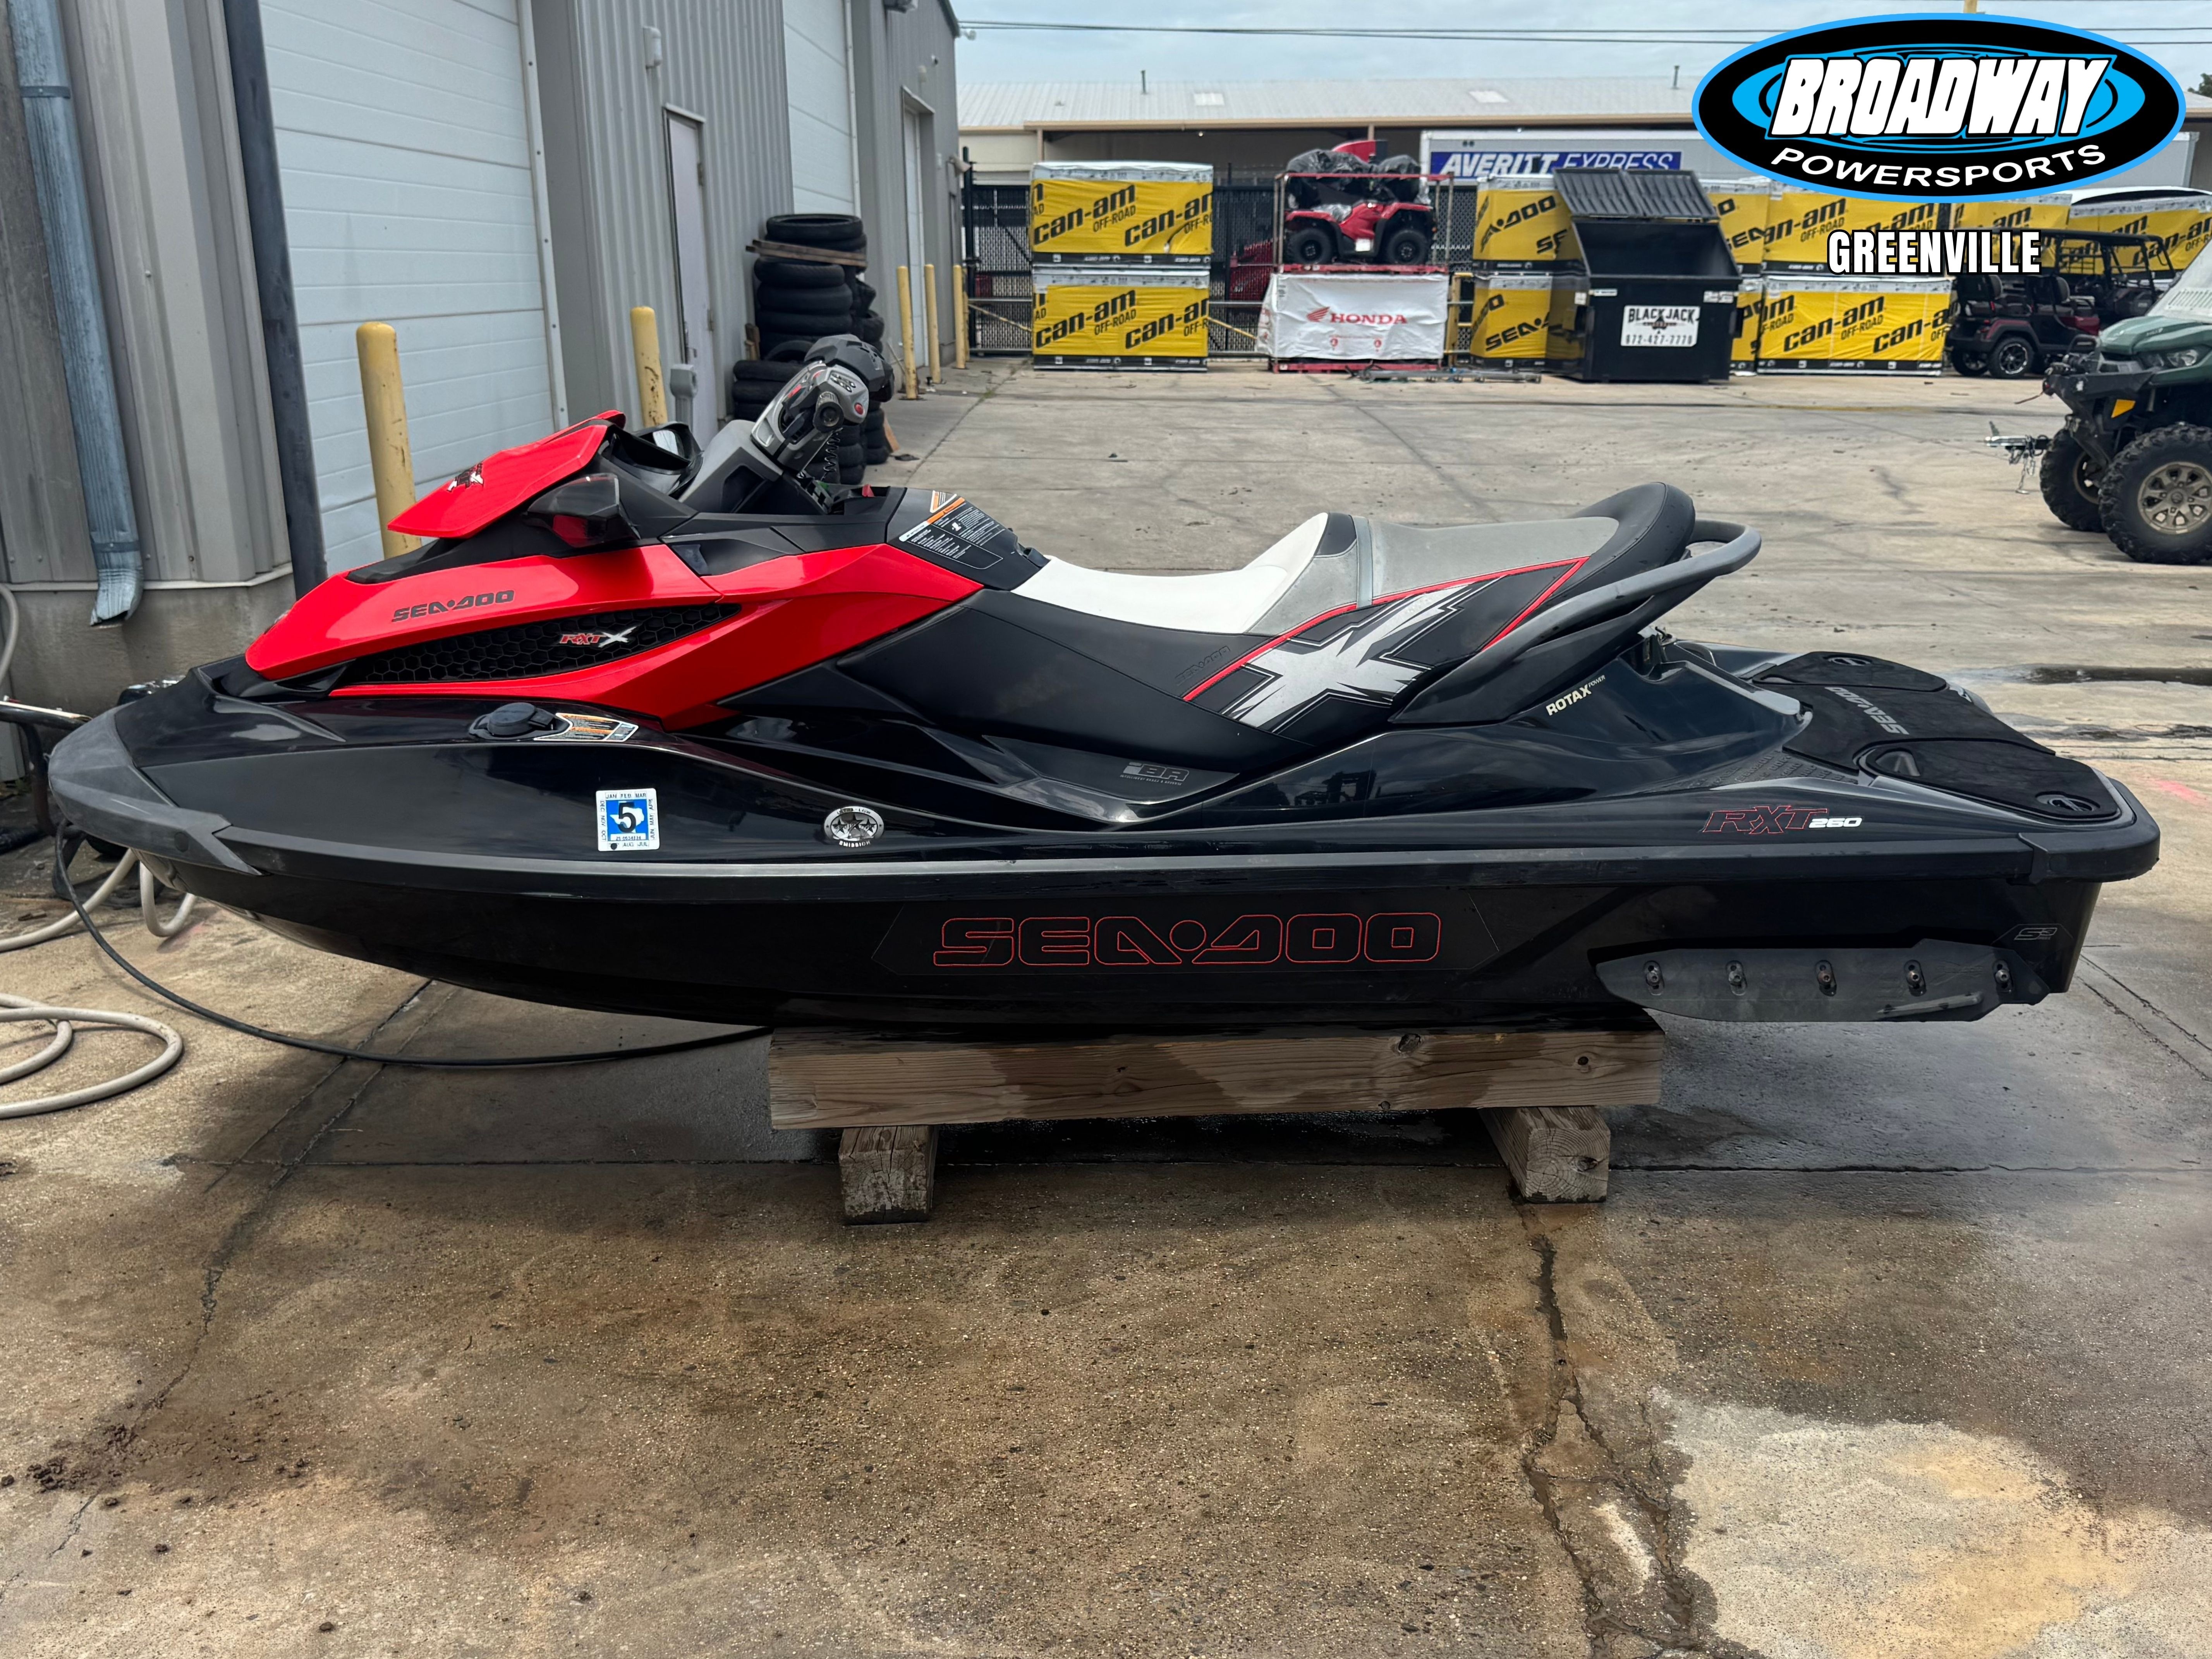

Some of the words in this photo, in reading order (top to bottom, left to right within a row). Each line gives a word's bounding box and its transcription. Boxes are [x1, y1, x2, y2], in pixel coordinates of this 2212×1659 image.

[1439, 154, 1561, 175] AVERITT
[1034, 184, 1135, 246] can-am
[1093, 205, 1136, 232] OFF-ROAD
[1800, 216, 1845, 243] OFF-ROAD
[1036, 290, 1136, 349] can-am
[1094, 309, 1137, 335] OFF-ROAD
[1330, 313, 1407, 324] HONDA
[1784, 296, 1884, 352] can-am
[1841, 314, 1884, 340] OFF-ROAD
[1546, 684, 1592, 716] ROTAX
[1588, 675, 1605, 687] POWER
[618, 802, 637, 833] 5
[1702, 805, 1828, 834] RXT
[1808, 817, 1862, 828] 260
